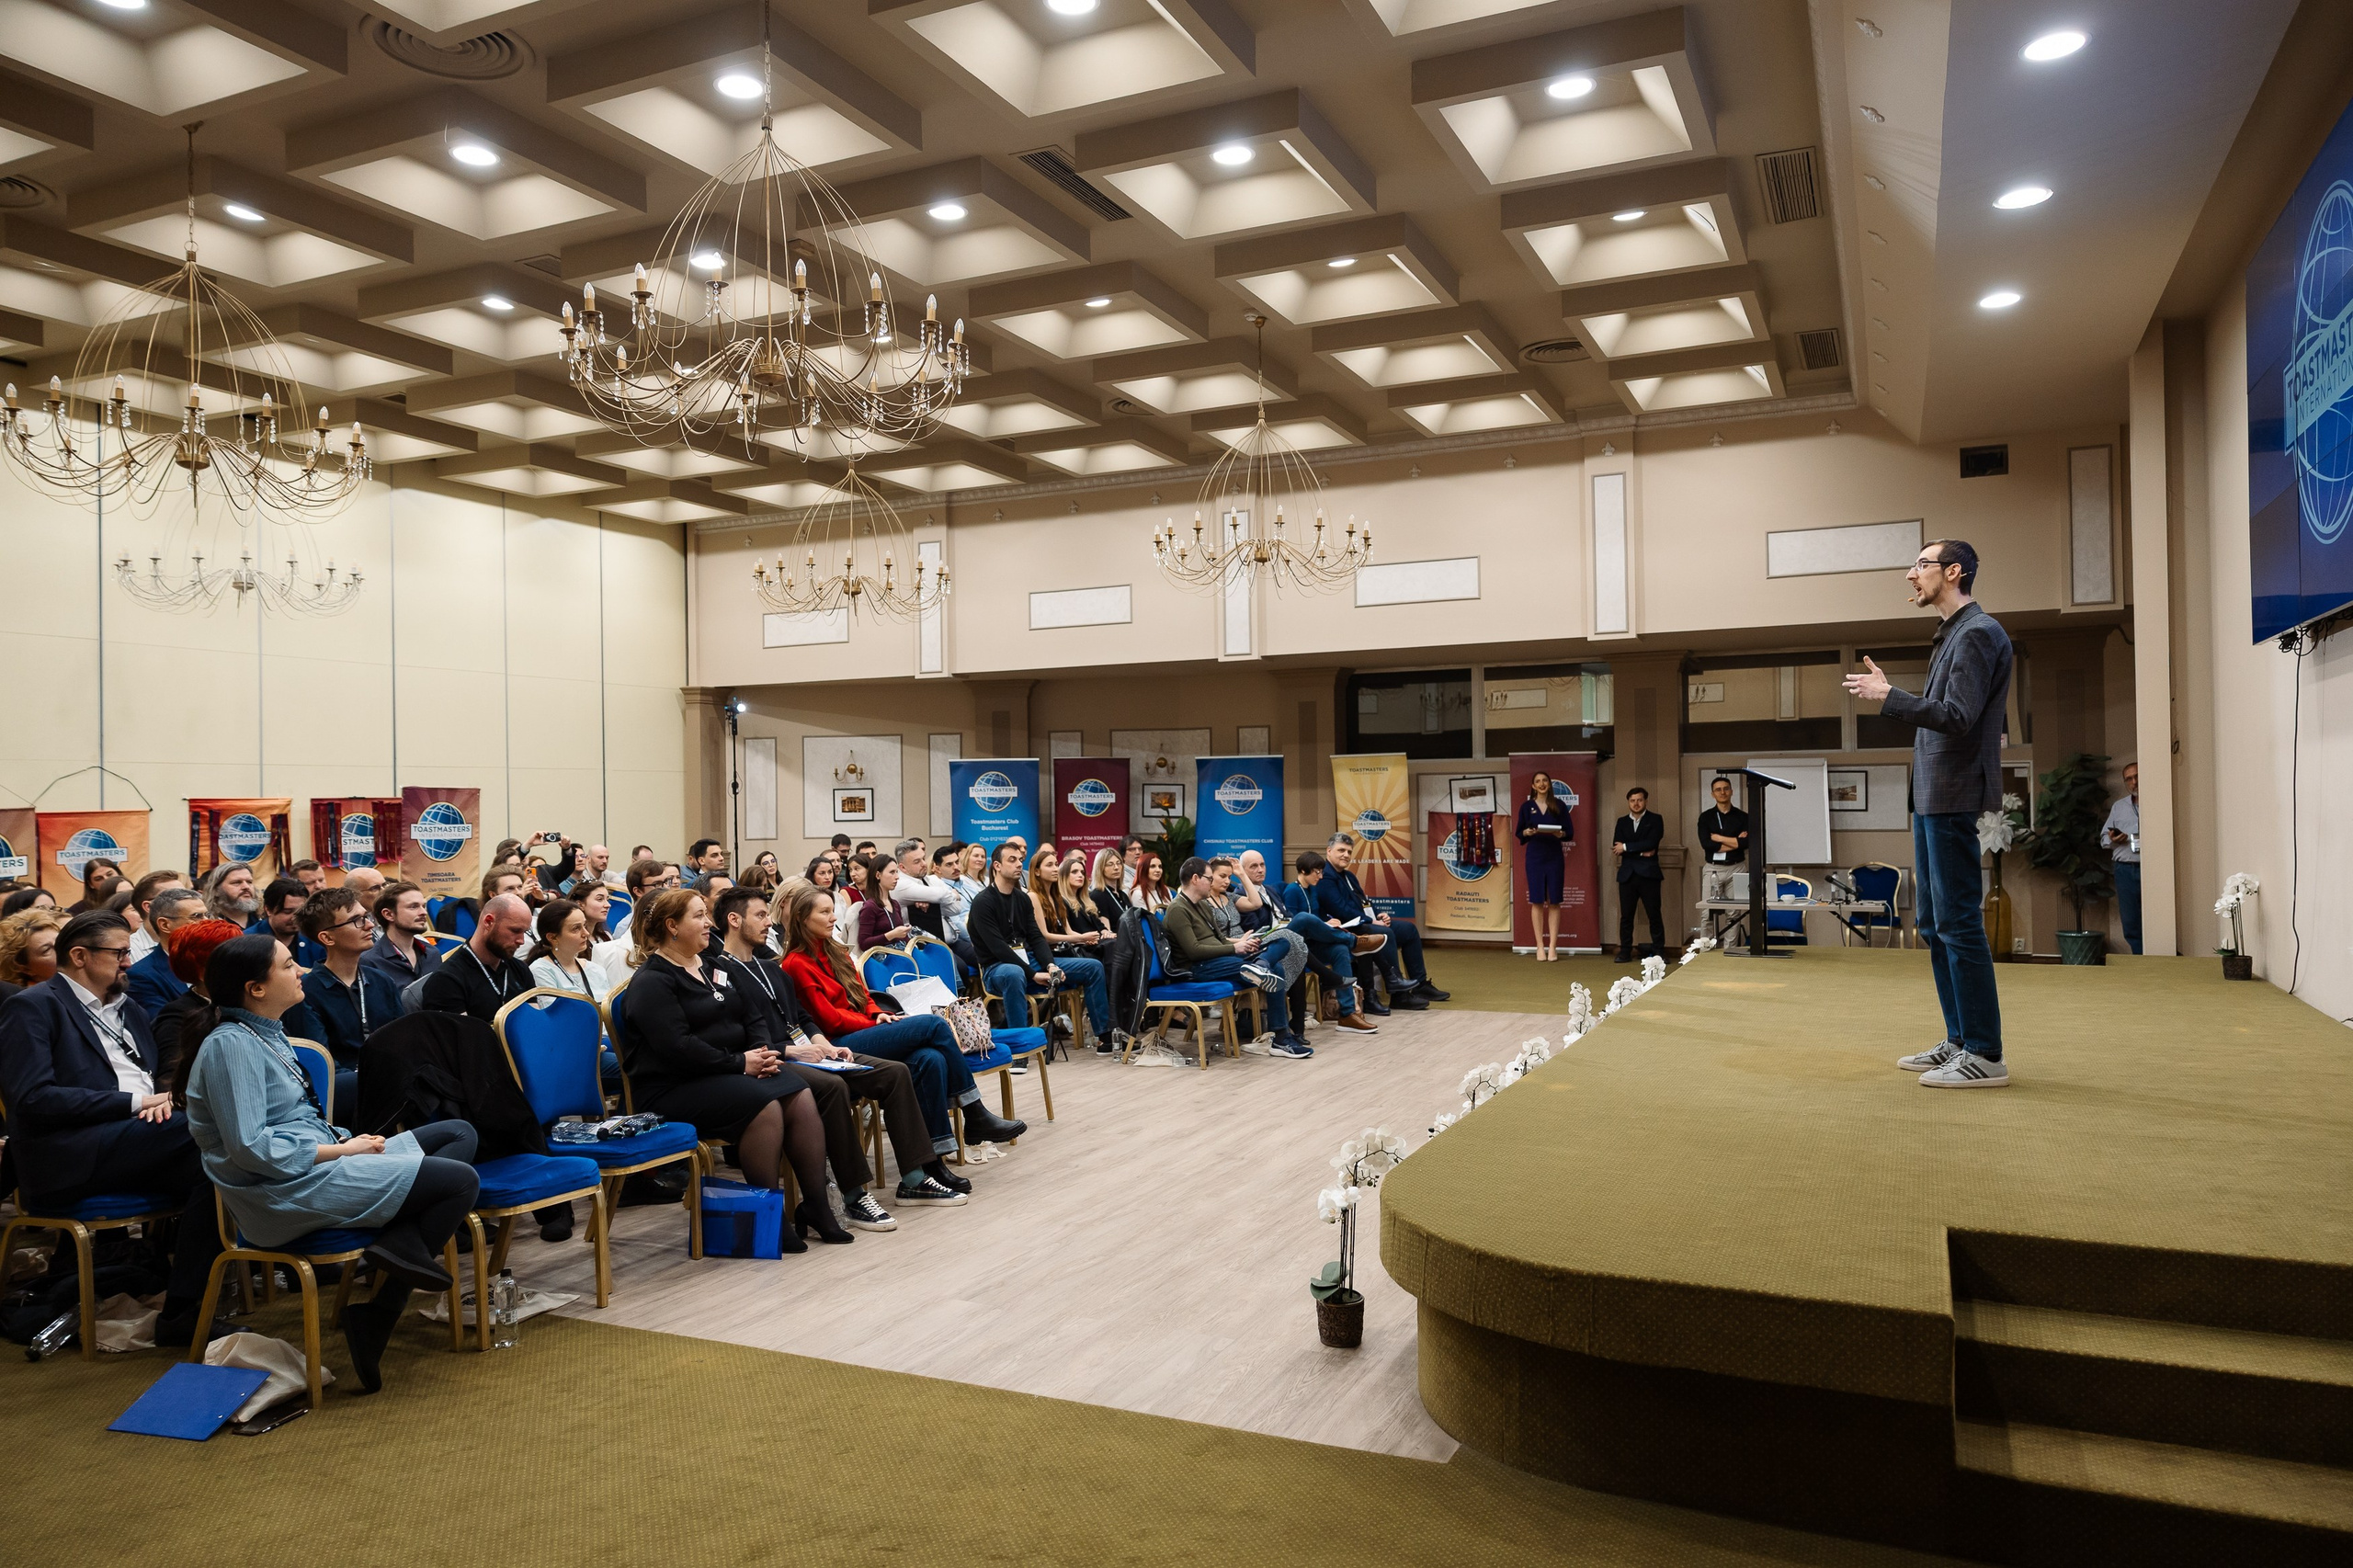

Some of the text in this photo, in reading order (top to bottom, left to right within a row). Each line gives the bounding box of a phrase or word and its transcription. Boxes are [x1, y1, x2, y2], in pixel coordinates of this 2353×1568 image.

[2288, 312, 2353, 407] TOASTMAST
[2297, 355, 2353, 425] INTERNATION
[59, 849, 126, 858] TOASTMASTERS
